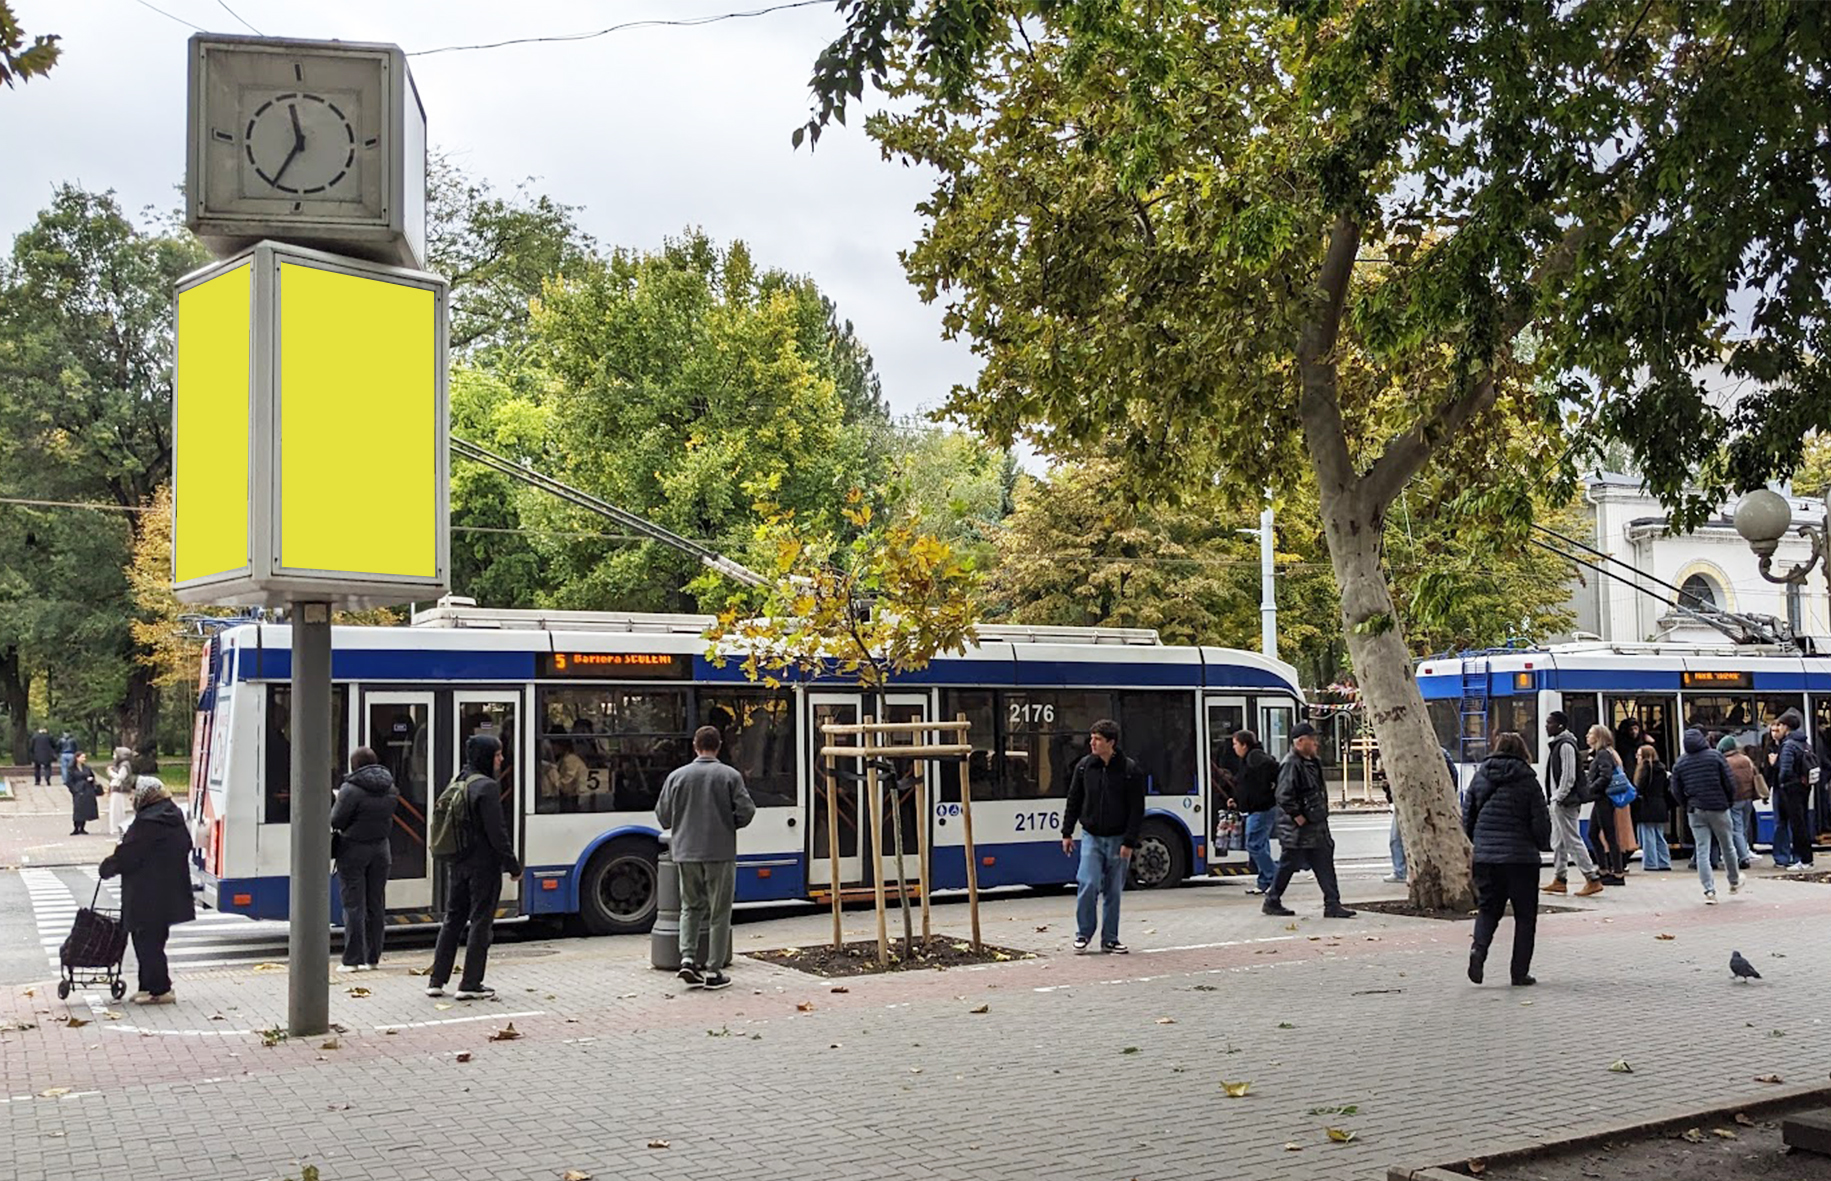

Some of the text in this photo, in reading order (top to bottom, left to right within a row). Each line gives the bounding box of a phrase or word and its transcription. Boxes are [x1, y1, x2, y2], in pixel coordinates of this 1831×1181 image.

[555, 654, 565, 669] 5
[1009, 704, 1054, 722] 2176
[587, 771, 600, 790] 5
[1015, 812, 1060, 831] 2176
